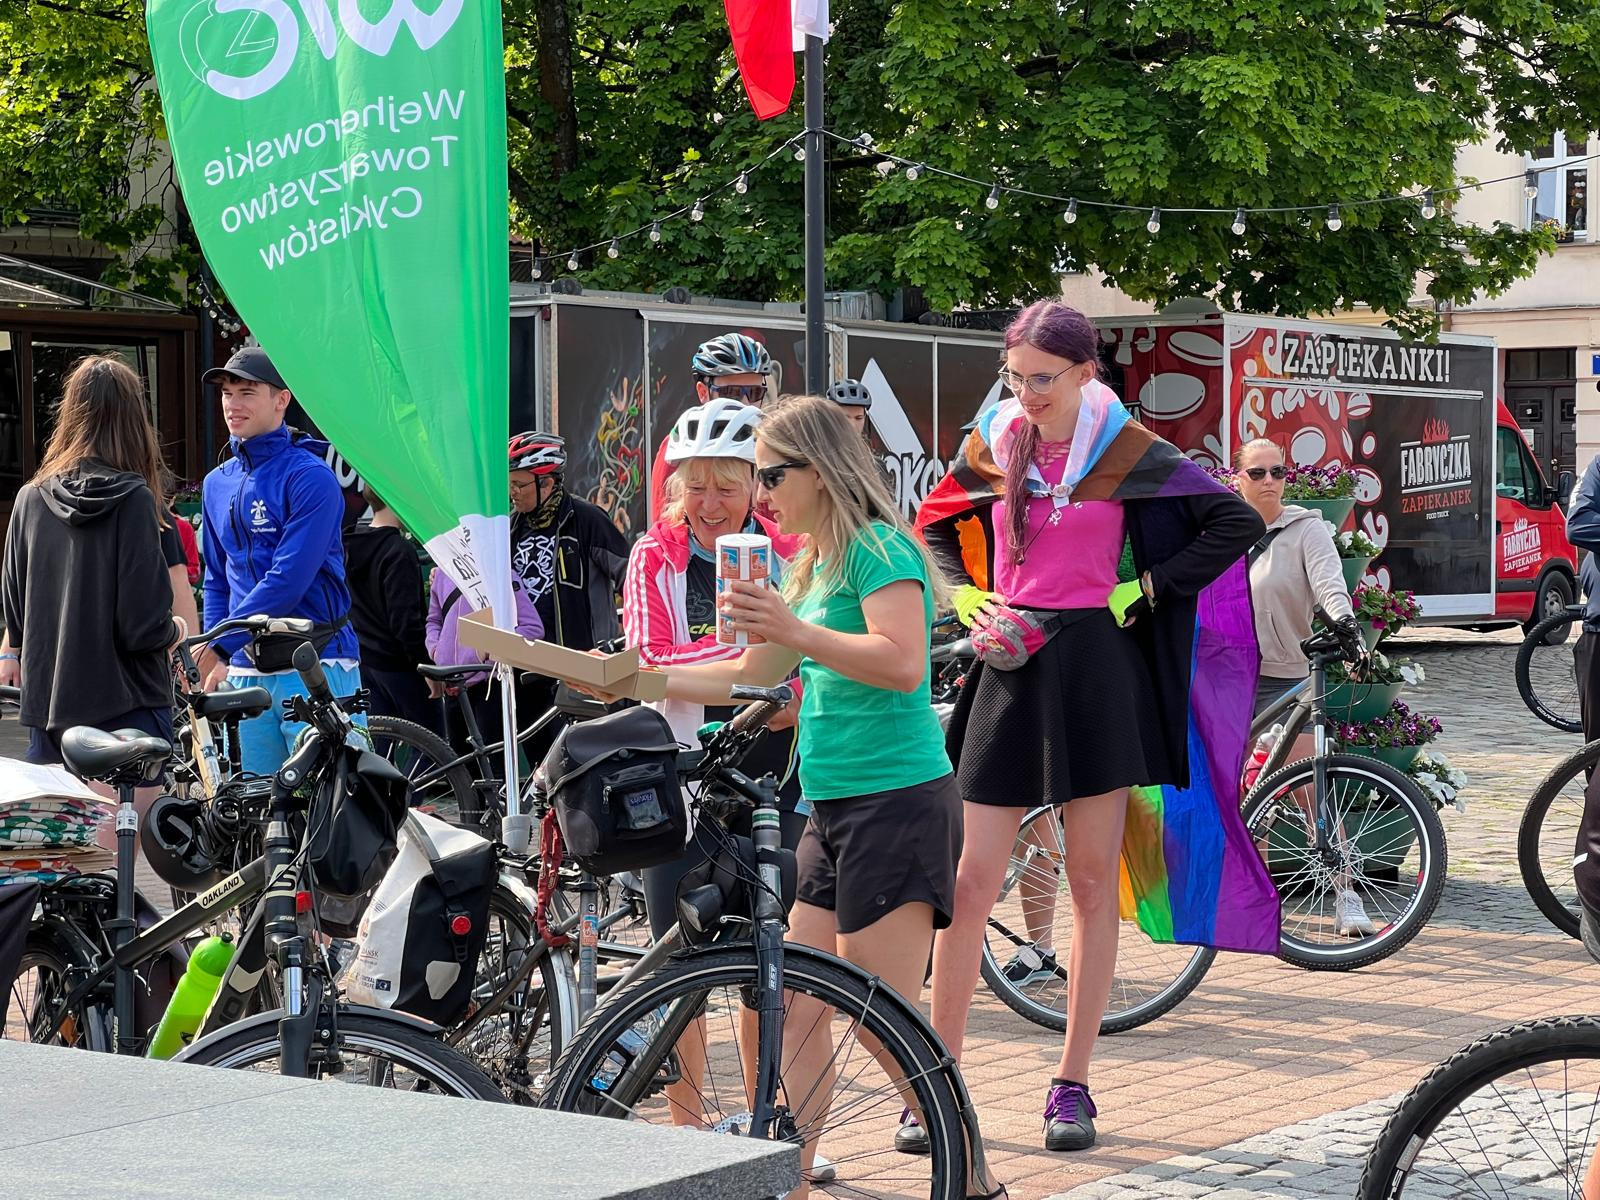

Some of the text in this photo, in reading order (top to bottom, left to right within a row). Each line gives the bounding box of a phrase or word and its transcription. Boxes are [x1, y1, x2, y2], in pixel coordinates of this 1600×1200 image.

[1283, 337, 1451, 383] ZAPIEKANKI!
[1400, 441, 1472, 487] FABRYCZKA
[1401, 489, 1472, 513] ZAPIEKANEK
[1503, 526, 1541, 558] FABRYCZKA
[1503, 551, 1542, 573] ZAPIEKANEK
[202, 875, 241, 907] OAKLAND
